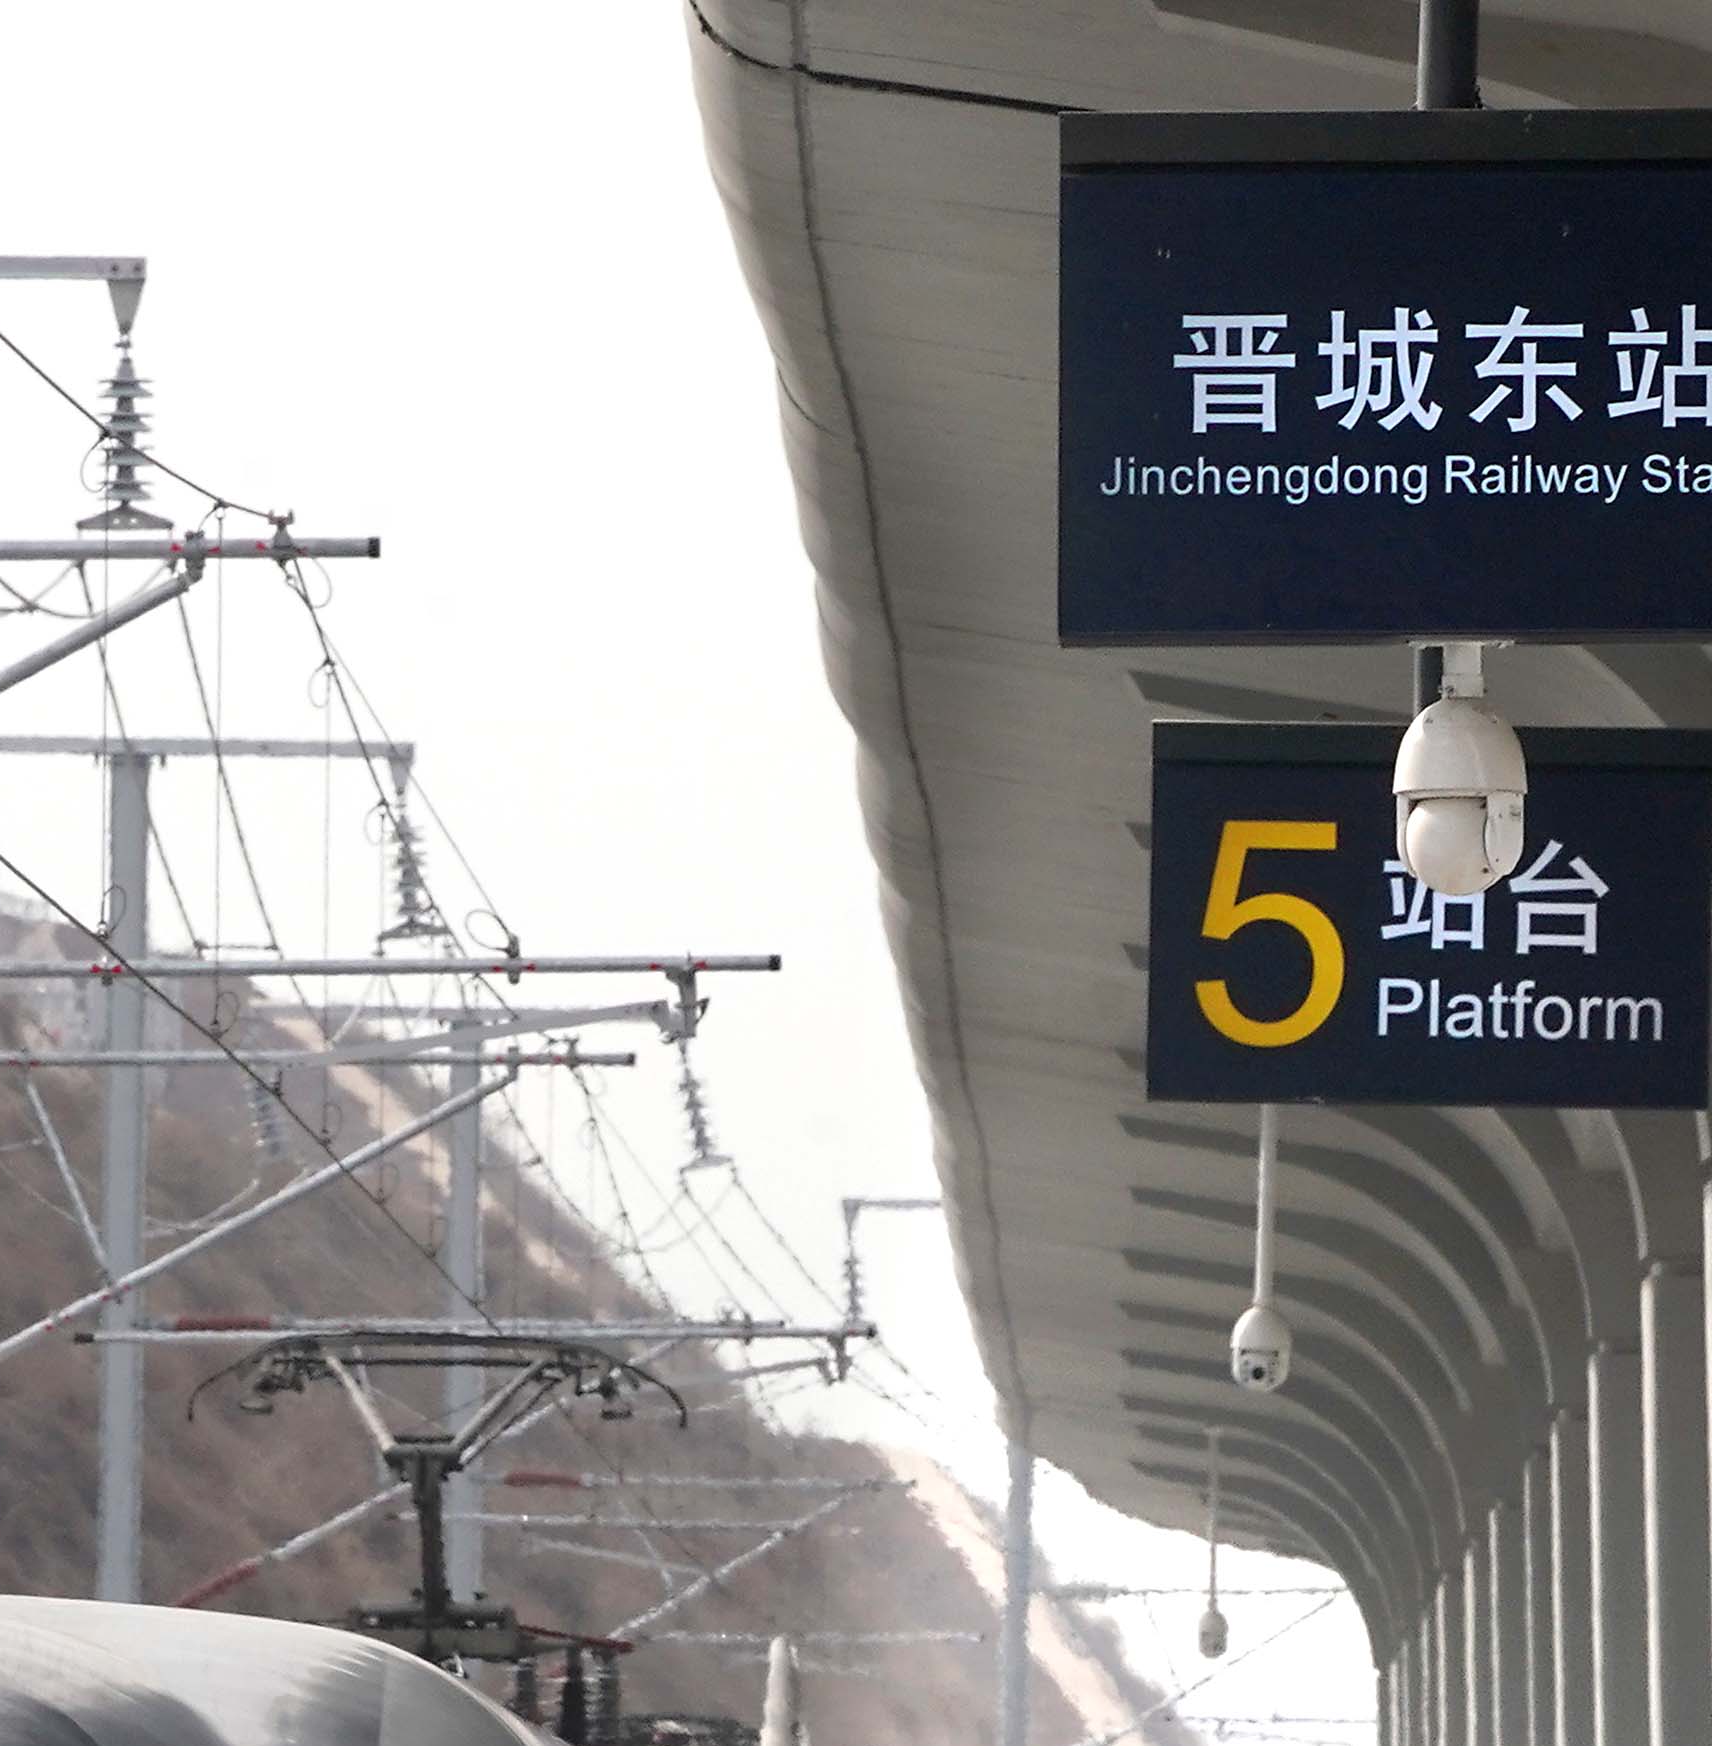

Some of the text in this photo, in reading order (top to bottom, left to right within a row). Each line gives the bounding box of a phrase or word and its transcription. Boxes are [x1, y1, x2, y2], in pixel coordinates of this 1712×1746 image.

[1099, 455, 1429, 505] Jinchengdong
[1443, 453, 1629, 504] Railway
[1194, 819, 1345, 1049] 5
[1377, 977, 1664, 1042] Platform
